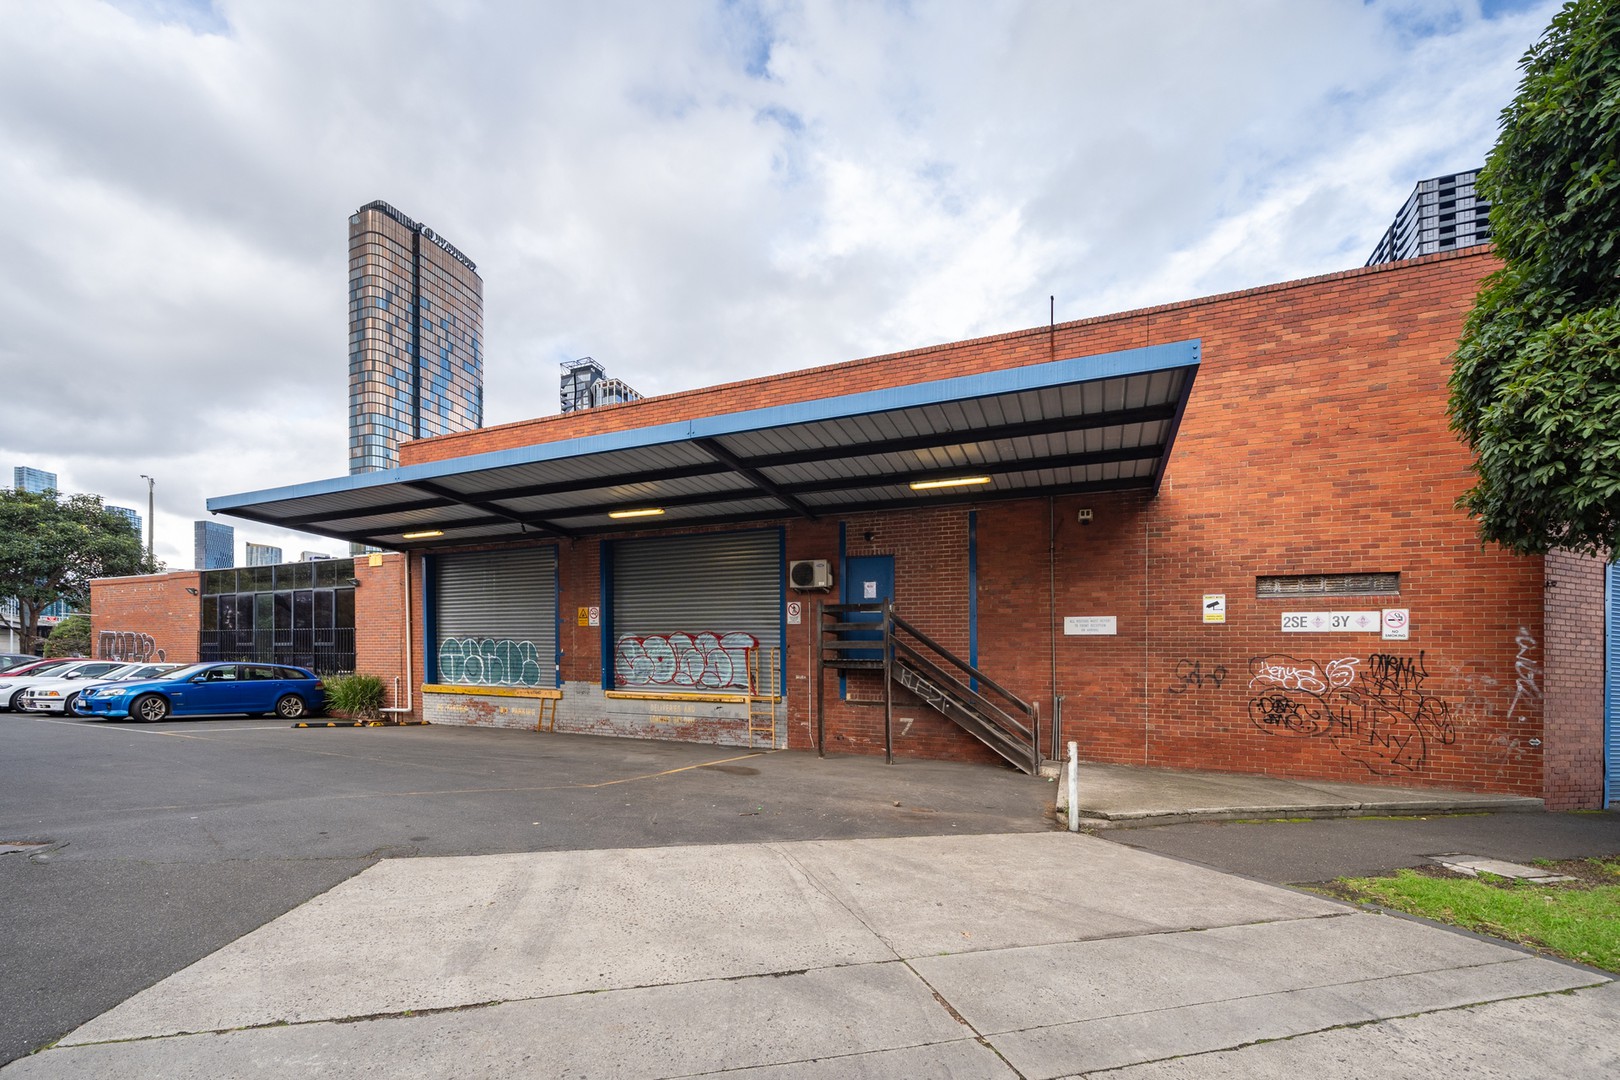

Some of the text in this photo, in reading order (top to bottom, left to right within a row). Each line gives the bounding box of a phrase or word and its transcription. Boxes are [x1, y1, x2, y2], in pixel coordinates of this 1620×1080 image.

[1283, 616, 1308, 628] 2SE
[1332, 615, 1350, 628] 3Y
[511, 707, 536, 716] PARKING
[650, 703, 696, 713] DELIVERIES AND
[899, 717, 915, 736] 7
